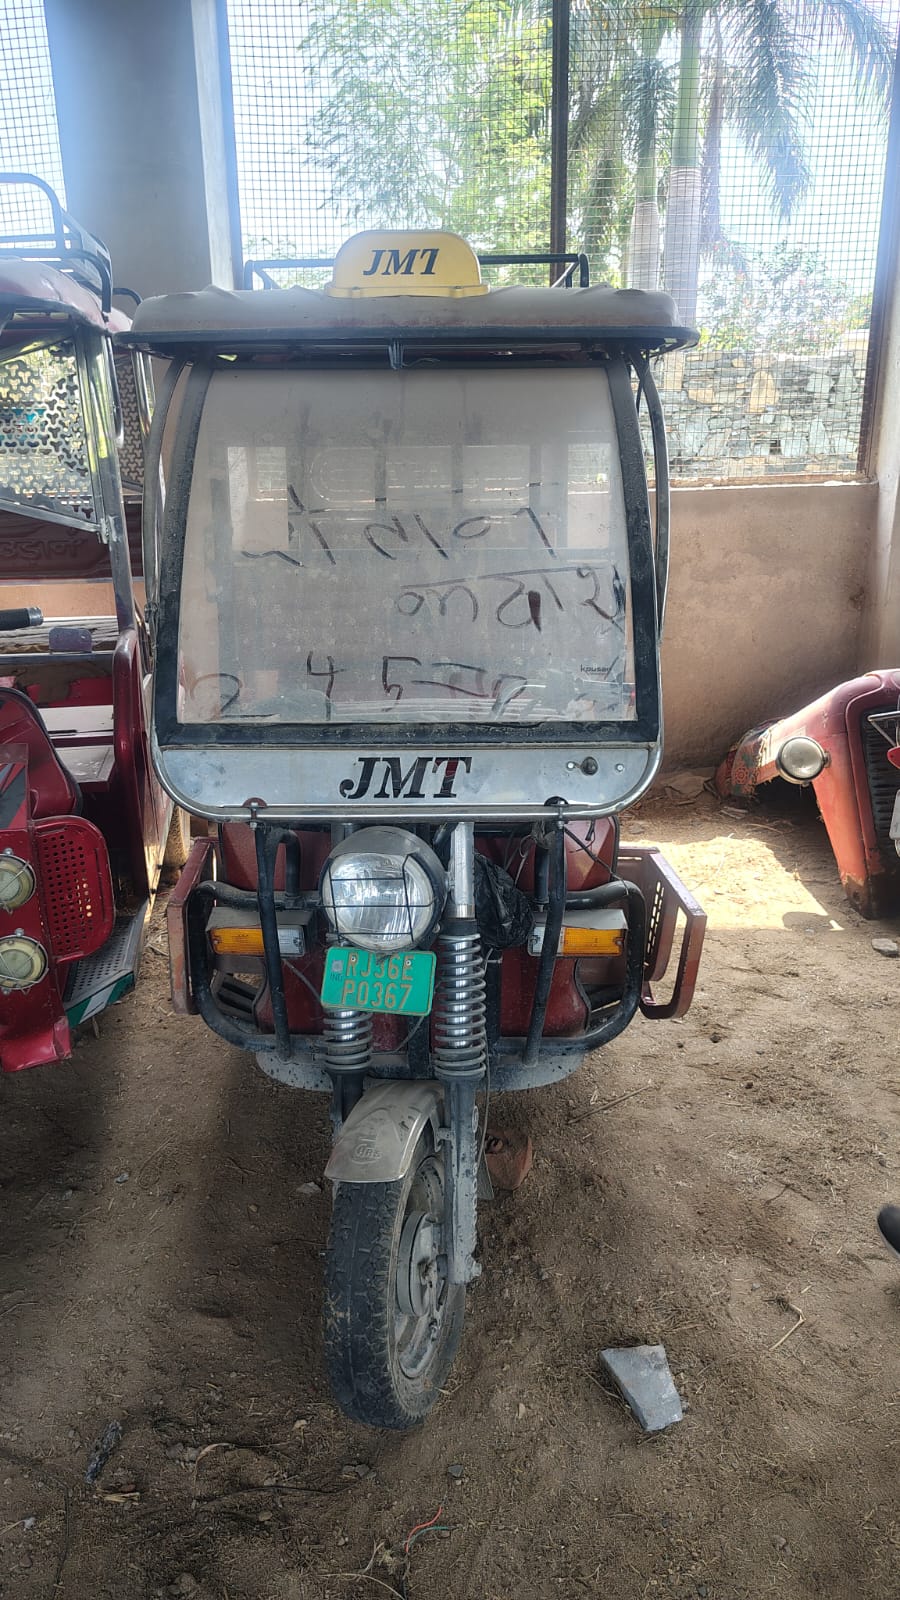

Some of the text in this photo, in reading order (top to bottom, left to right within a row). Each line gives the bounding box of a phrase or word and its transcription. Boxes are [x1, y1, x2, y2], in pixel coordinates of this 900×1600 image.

[363, 248, 440, 275] JMT
[339, 756, 472, 800] JMT
[345, 952, 415, 981] RJ36E
[342, 979, 412, 1009] P0367
